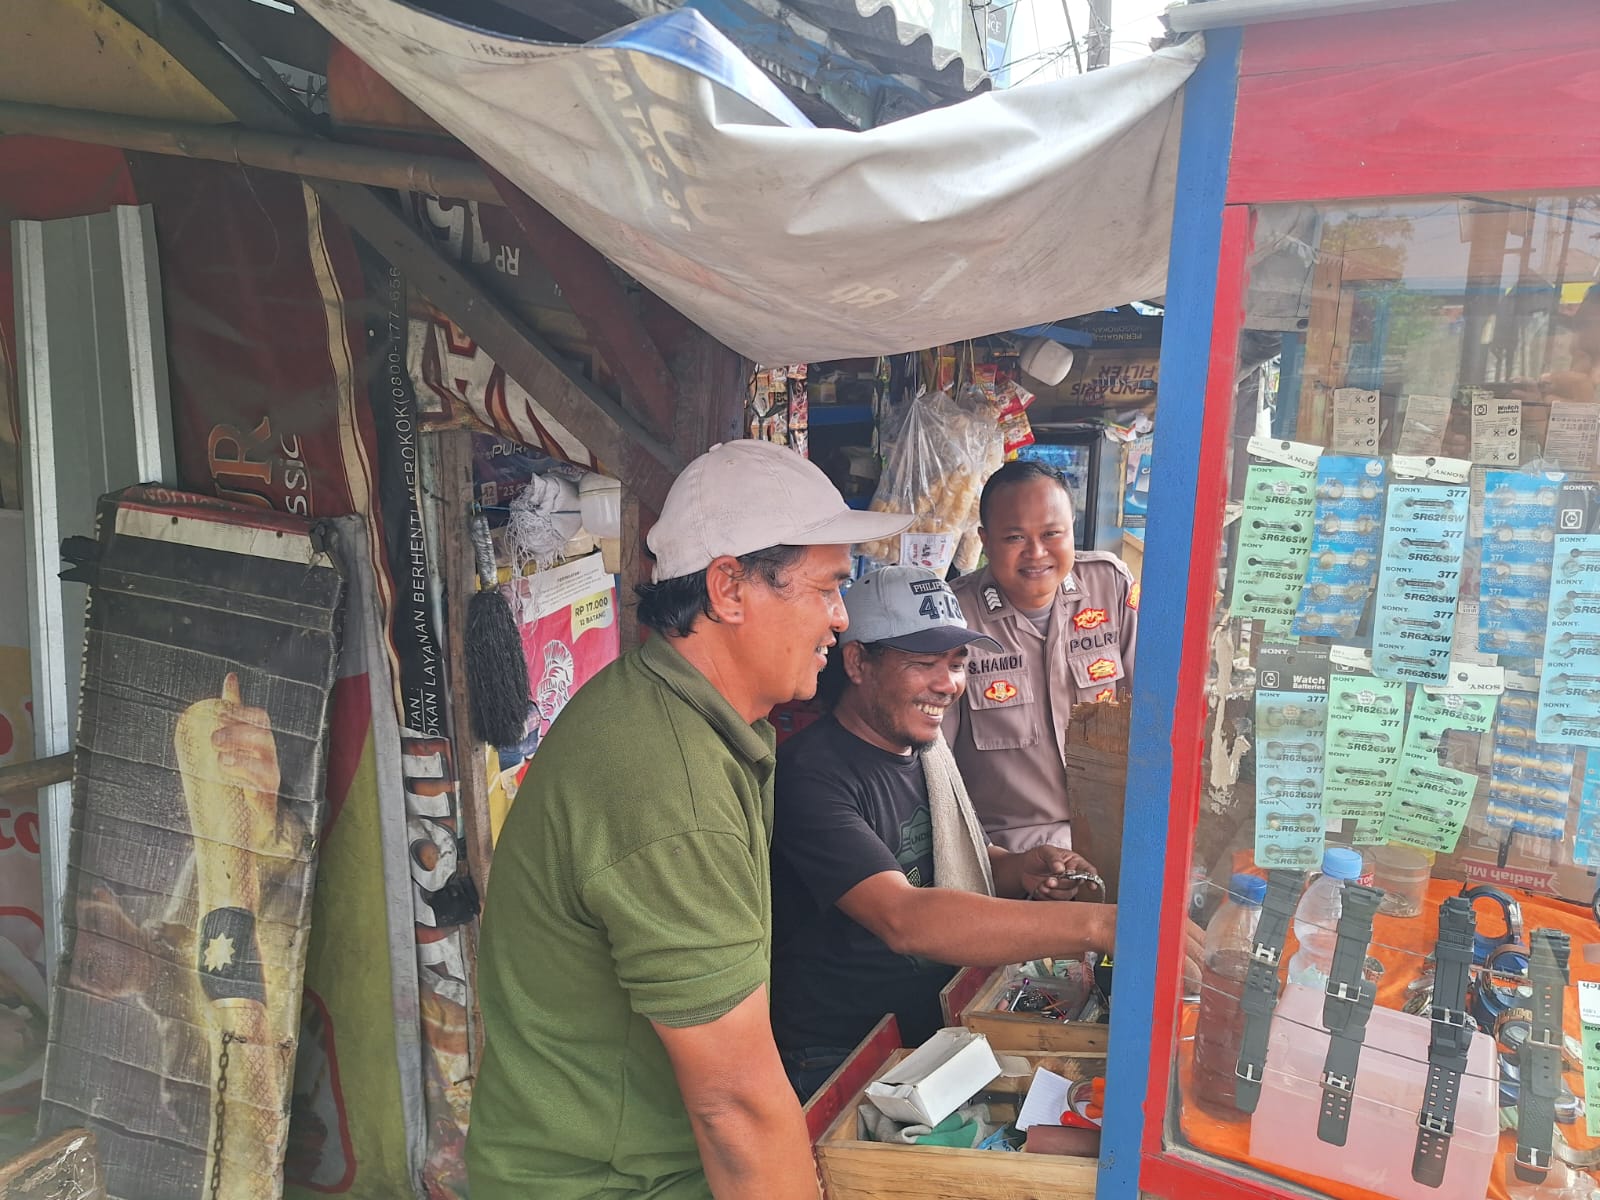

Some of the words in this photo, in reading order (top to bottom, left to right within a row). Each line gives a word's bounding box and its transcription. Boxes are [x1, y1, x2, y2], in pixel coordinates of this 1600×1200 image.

[495, 245, 520, 277] RP
[1446, 490, 1467, 498] 377
[1260, 533, 1308, 544] SR626SW
[1442, 530, 1463, 538] 377
[1408, 552, 1460, 562] SR626SW
[1438, 570, 1458, 579] 377
[1284, 584, 1303, 592] 377
[1404, 592, 1456, 604] SR626SW
[1433, 610, 1454, 619] 377
[1400, 631, 1451, 642] SR626SW
[1069, 631, 1119, 653] POLRI
[413, 610, 436, 686] LAYANAN
[1430, 649, 1450, 658] 377
[968, 655, 1024, 675] S.HAMDI
[1397, 668, 1448, 680] SR626SW
[1293, 675, 1326, 684] Watch
[1446, 799, 1466, 808] 377
[1491, 868, 1545, 888] Hadiah
